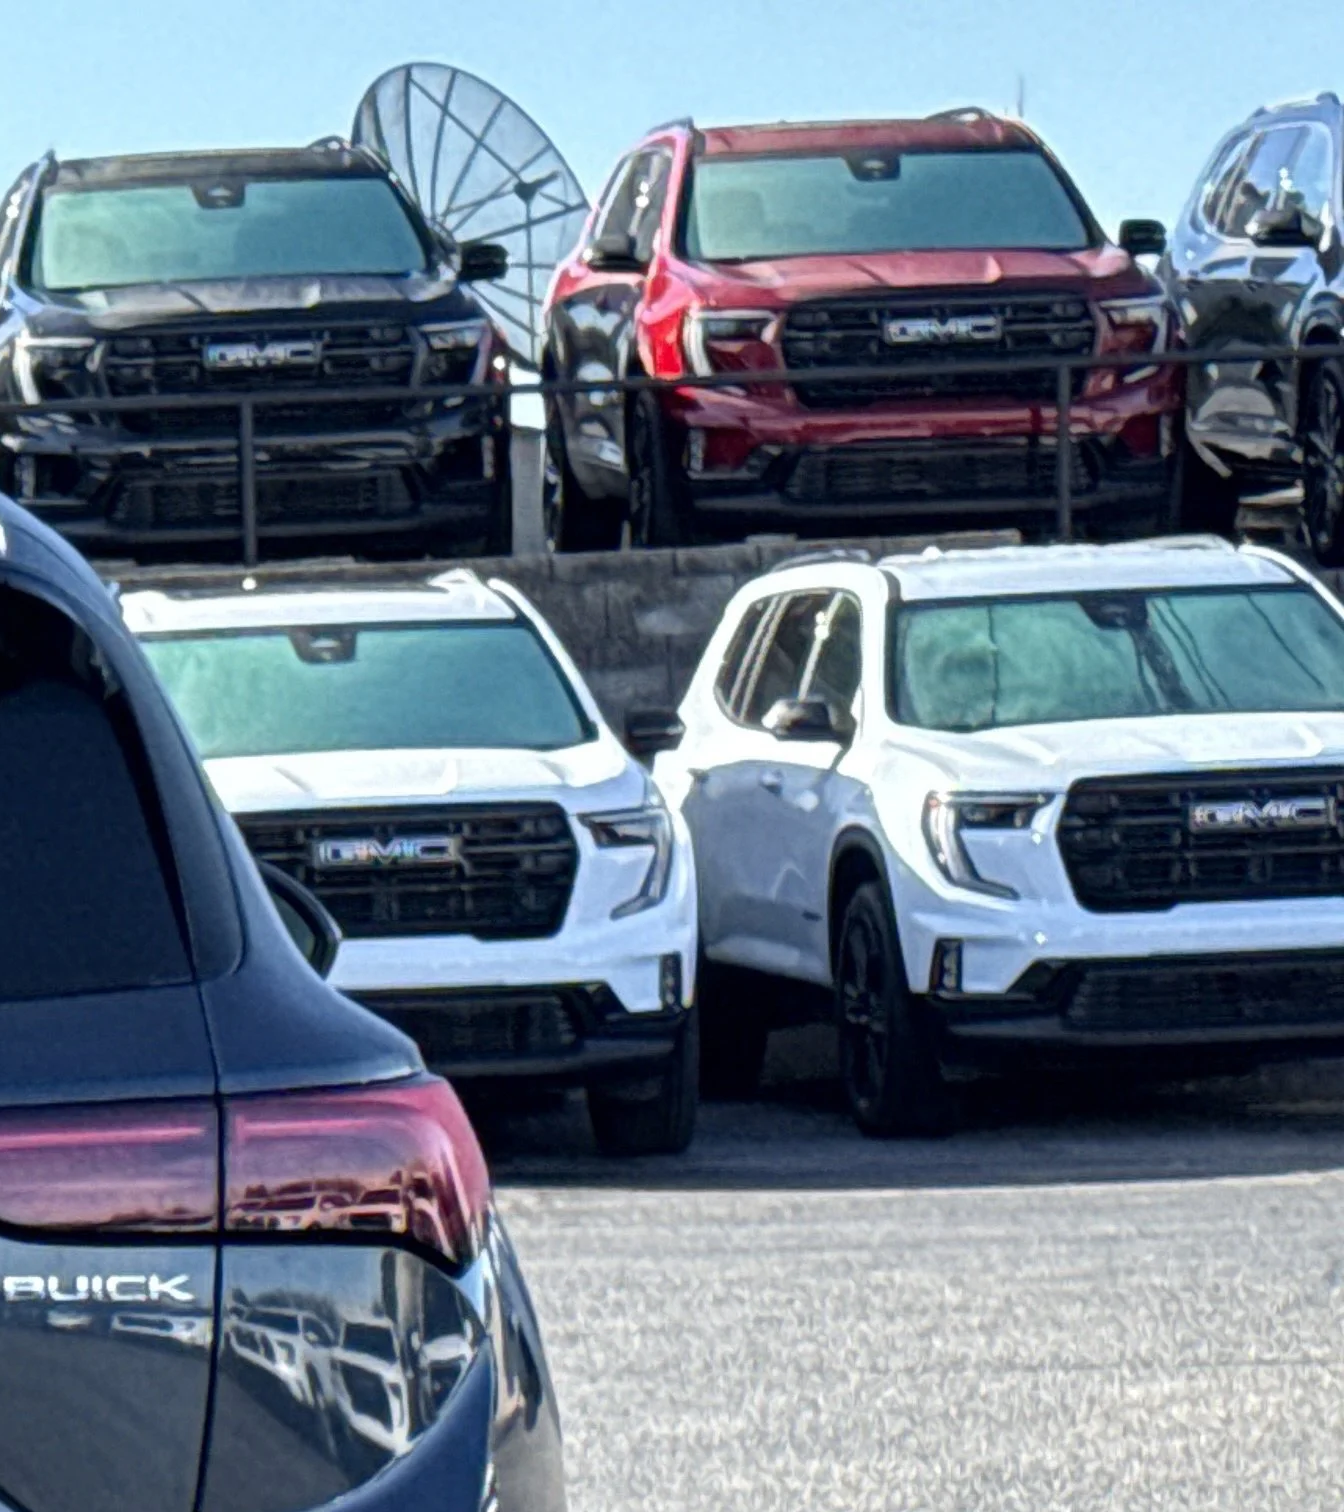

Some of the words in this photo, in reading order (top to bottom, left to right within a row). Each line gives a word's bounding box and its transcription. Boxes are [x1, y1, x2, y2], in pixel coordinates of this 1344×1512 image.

[886, 315, 1001, 344] GMC
[204, 340, 322, 369] GMC
[1192, 798, 1335, 832] GMC
[317, 836, 460, 867] GMC
[3, 1273, 195, 1301] BUICK
